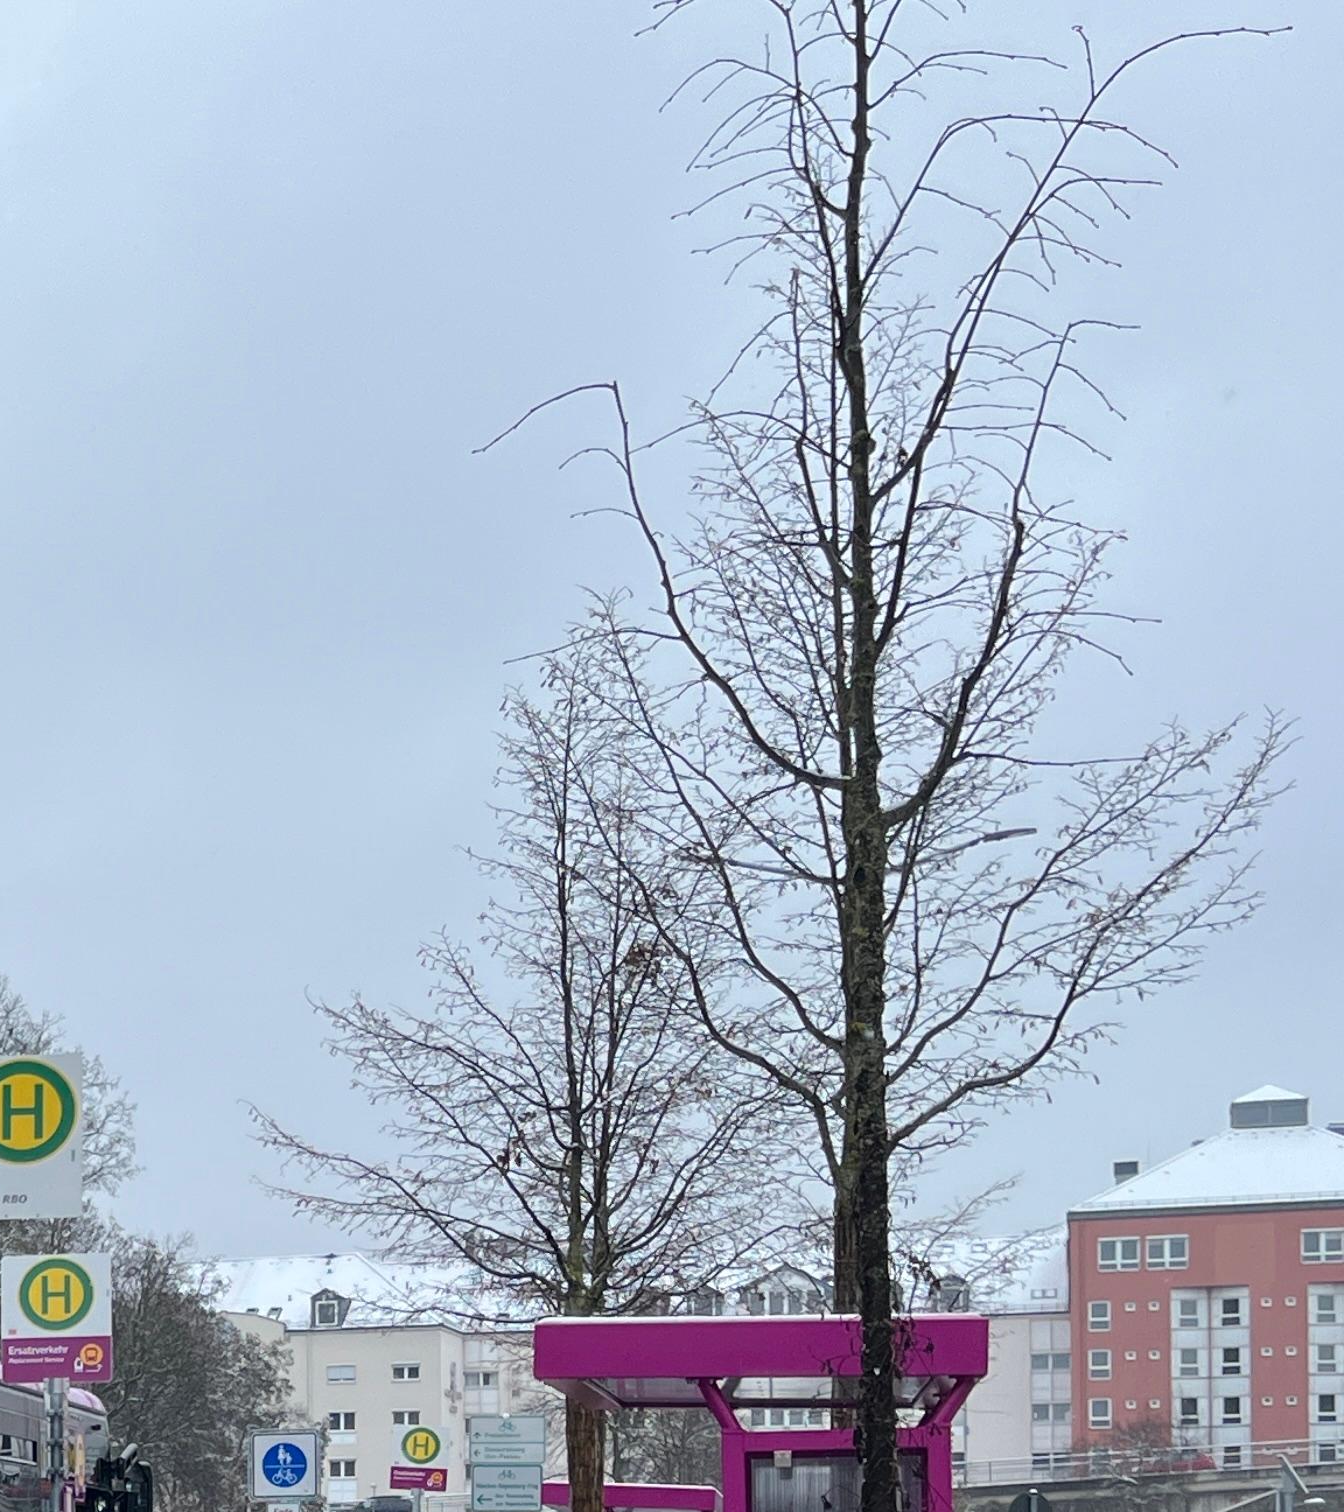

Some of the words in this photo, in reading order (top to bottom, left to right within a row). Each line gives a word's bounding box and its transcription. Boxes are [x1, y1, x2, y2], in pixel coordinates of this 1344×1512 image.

[1, 1083, 43, 1141] H
[2, 1194, 28, 1204] RBO
[41, 1274, 71, 1315] H
[412, 1435, 430, 1457] H
